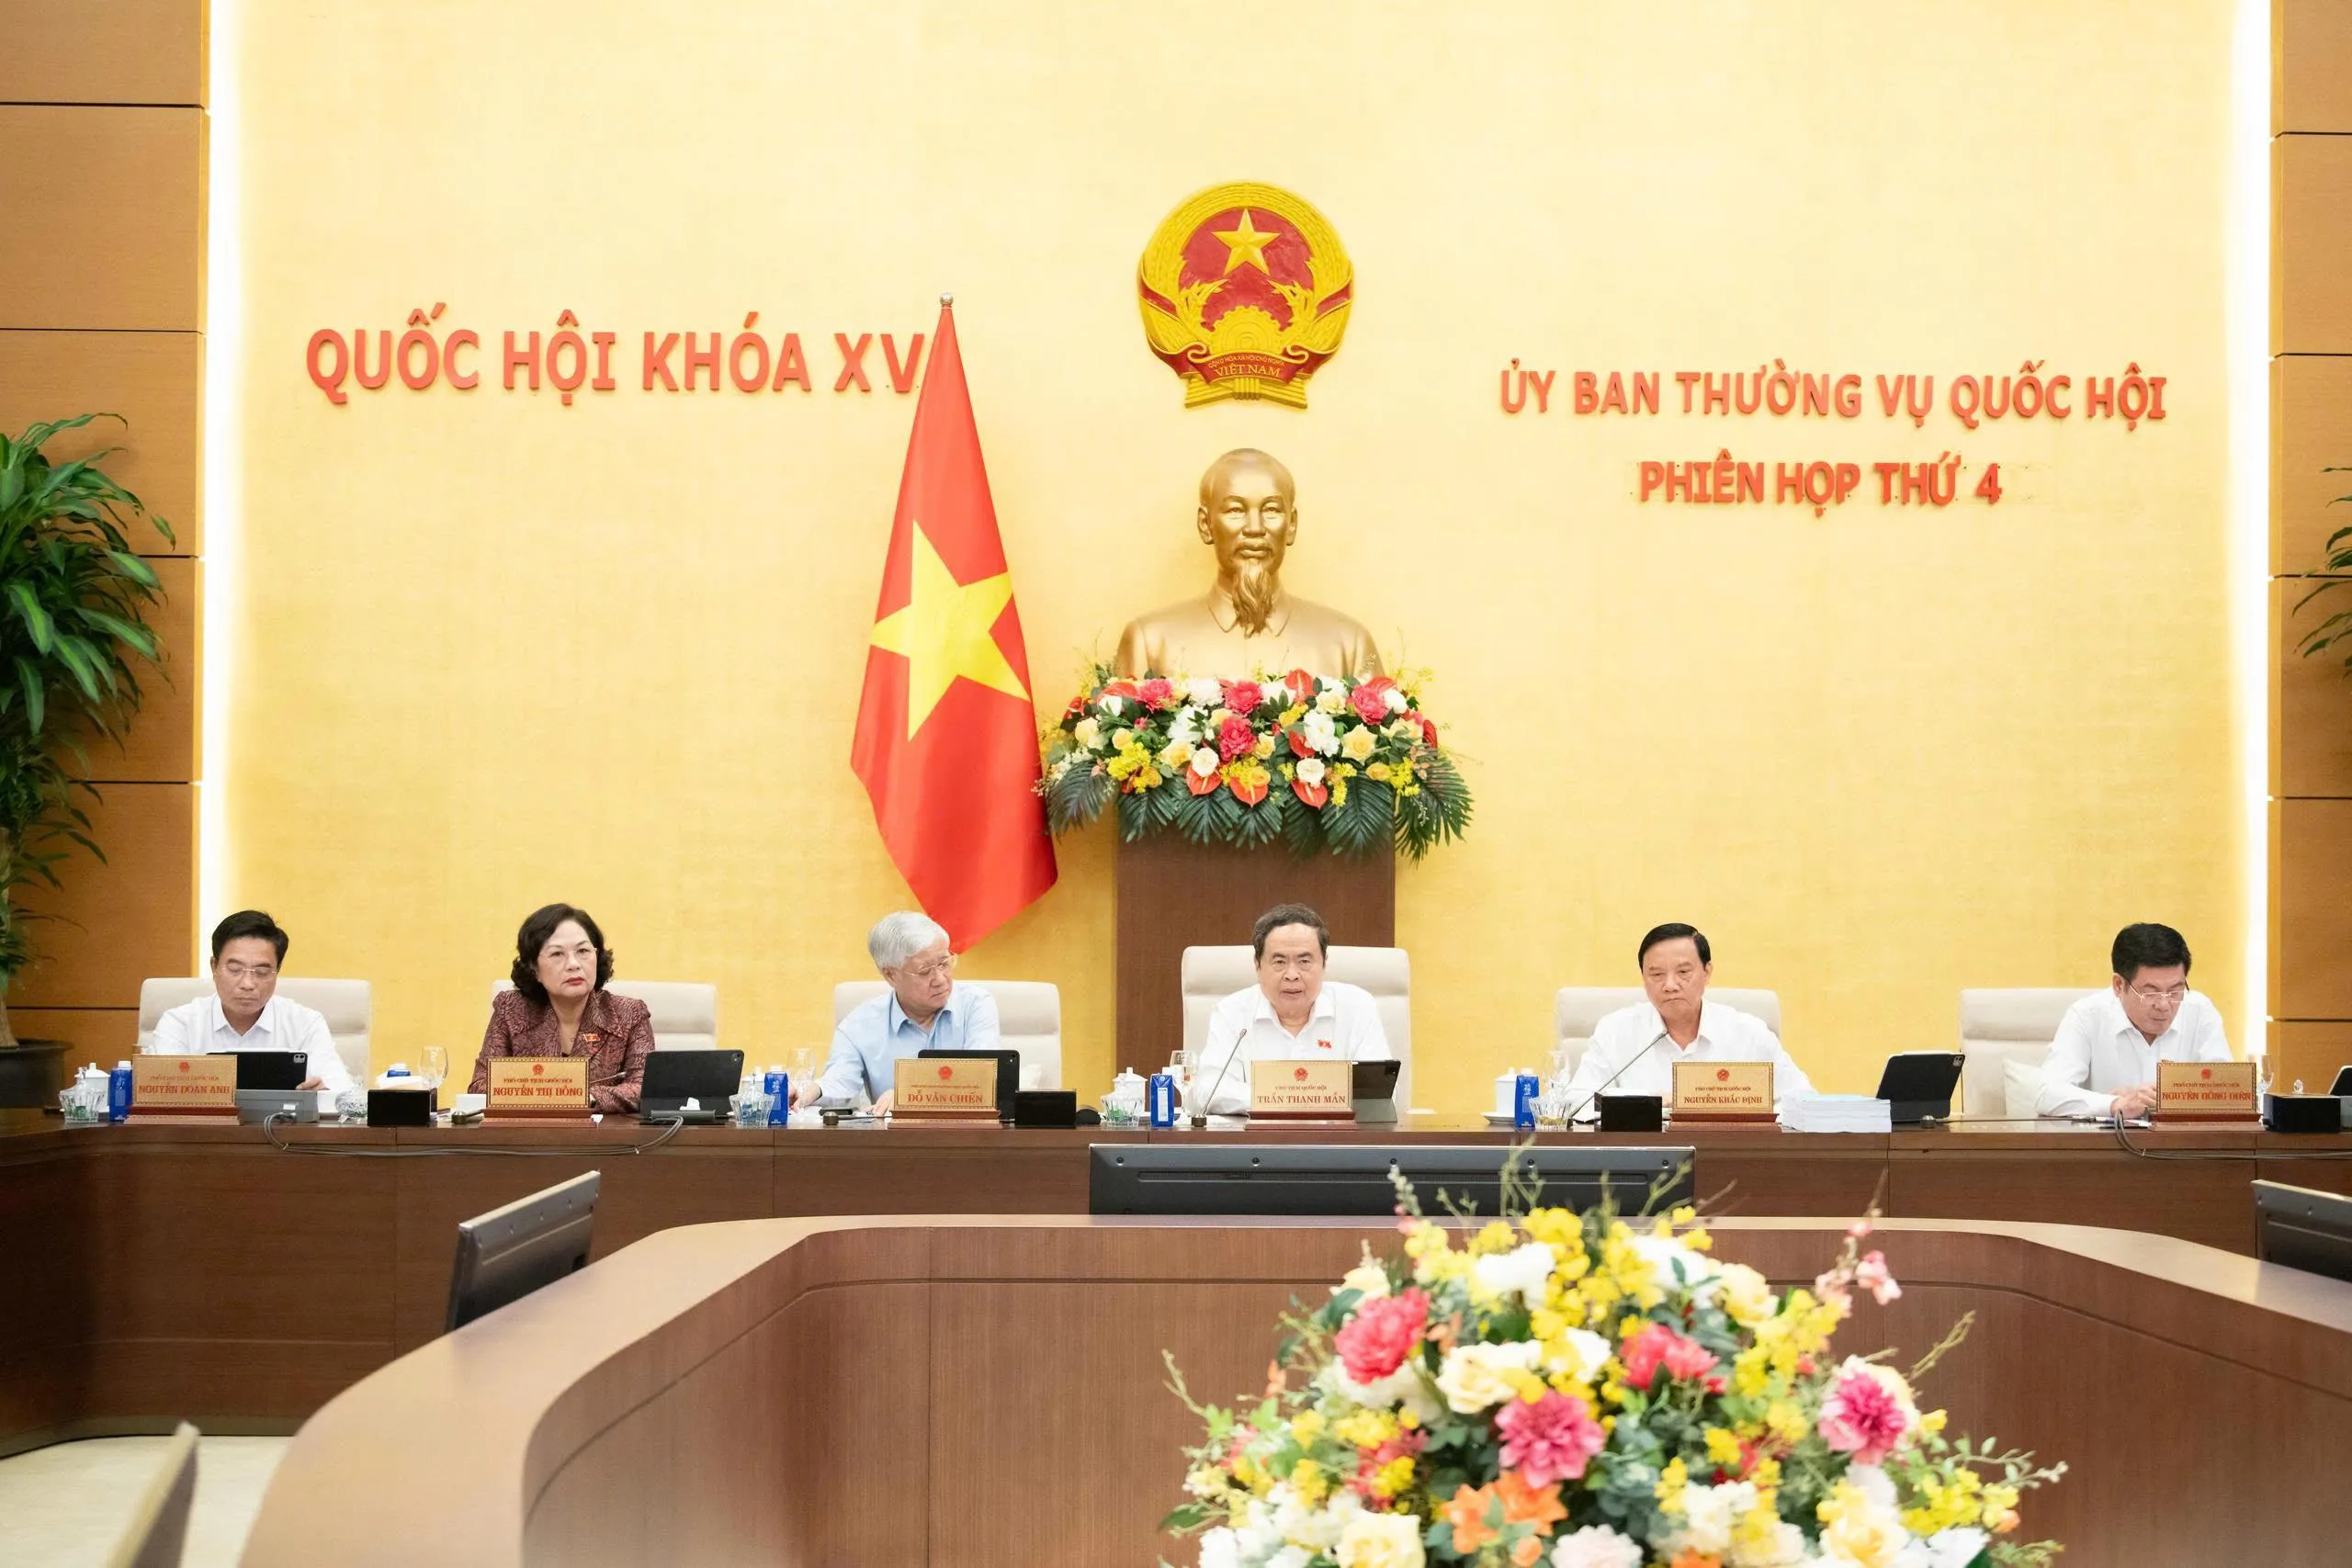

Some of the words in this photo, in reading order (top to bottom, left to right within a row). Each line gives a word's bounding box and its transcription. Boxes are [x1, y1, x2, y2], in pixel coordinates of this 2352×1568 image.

[306, 303, 480, 405] QUỐC
[503, 310, 616, 406] HỘI
[642, 311, 809, 393] KHÓA
[1247, 364, 1281, 377] NAM
[1500, 358, 1555, 413] ỦY
[1574, 371, 1659, 414] BAN
[1675, 358, 1861, 417] THƯỜNG
[1877, 375, 1933, 427] VỤ
[1950, 359, 2071, 430] QUỐC
[2086, 362, 2166, 432] HỘI
[1640, 448, 1765, 504] PHIÊN
[1775, 461, 1861, 518] HỌP
[1873, 451, 1962, 506] THỨ
[1975, 462, 2004, 505] 4
[209, 1085, 231, 1094] ANH
[536, 1088, 553, 1099] THỊ
[1286, 1095, 1321, 1103] THANH
[1742, 1096, 1763, 1105] ĐỊNH
